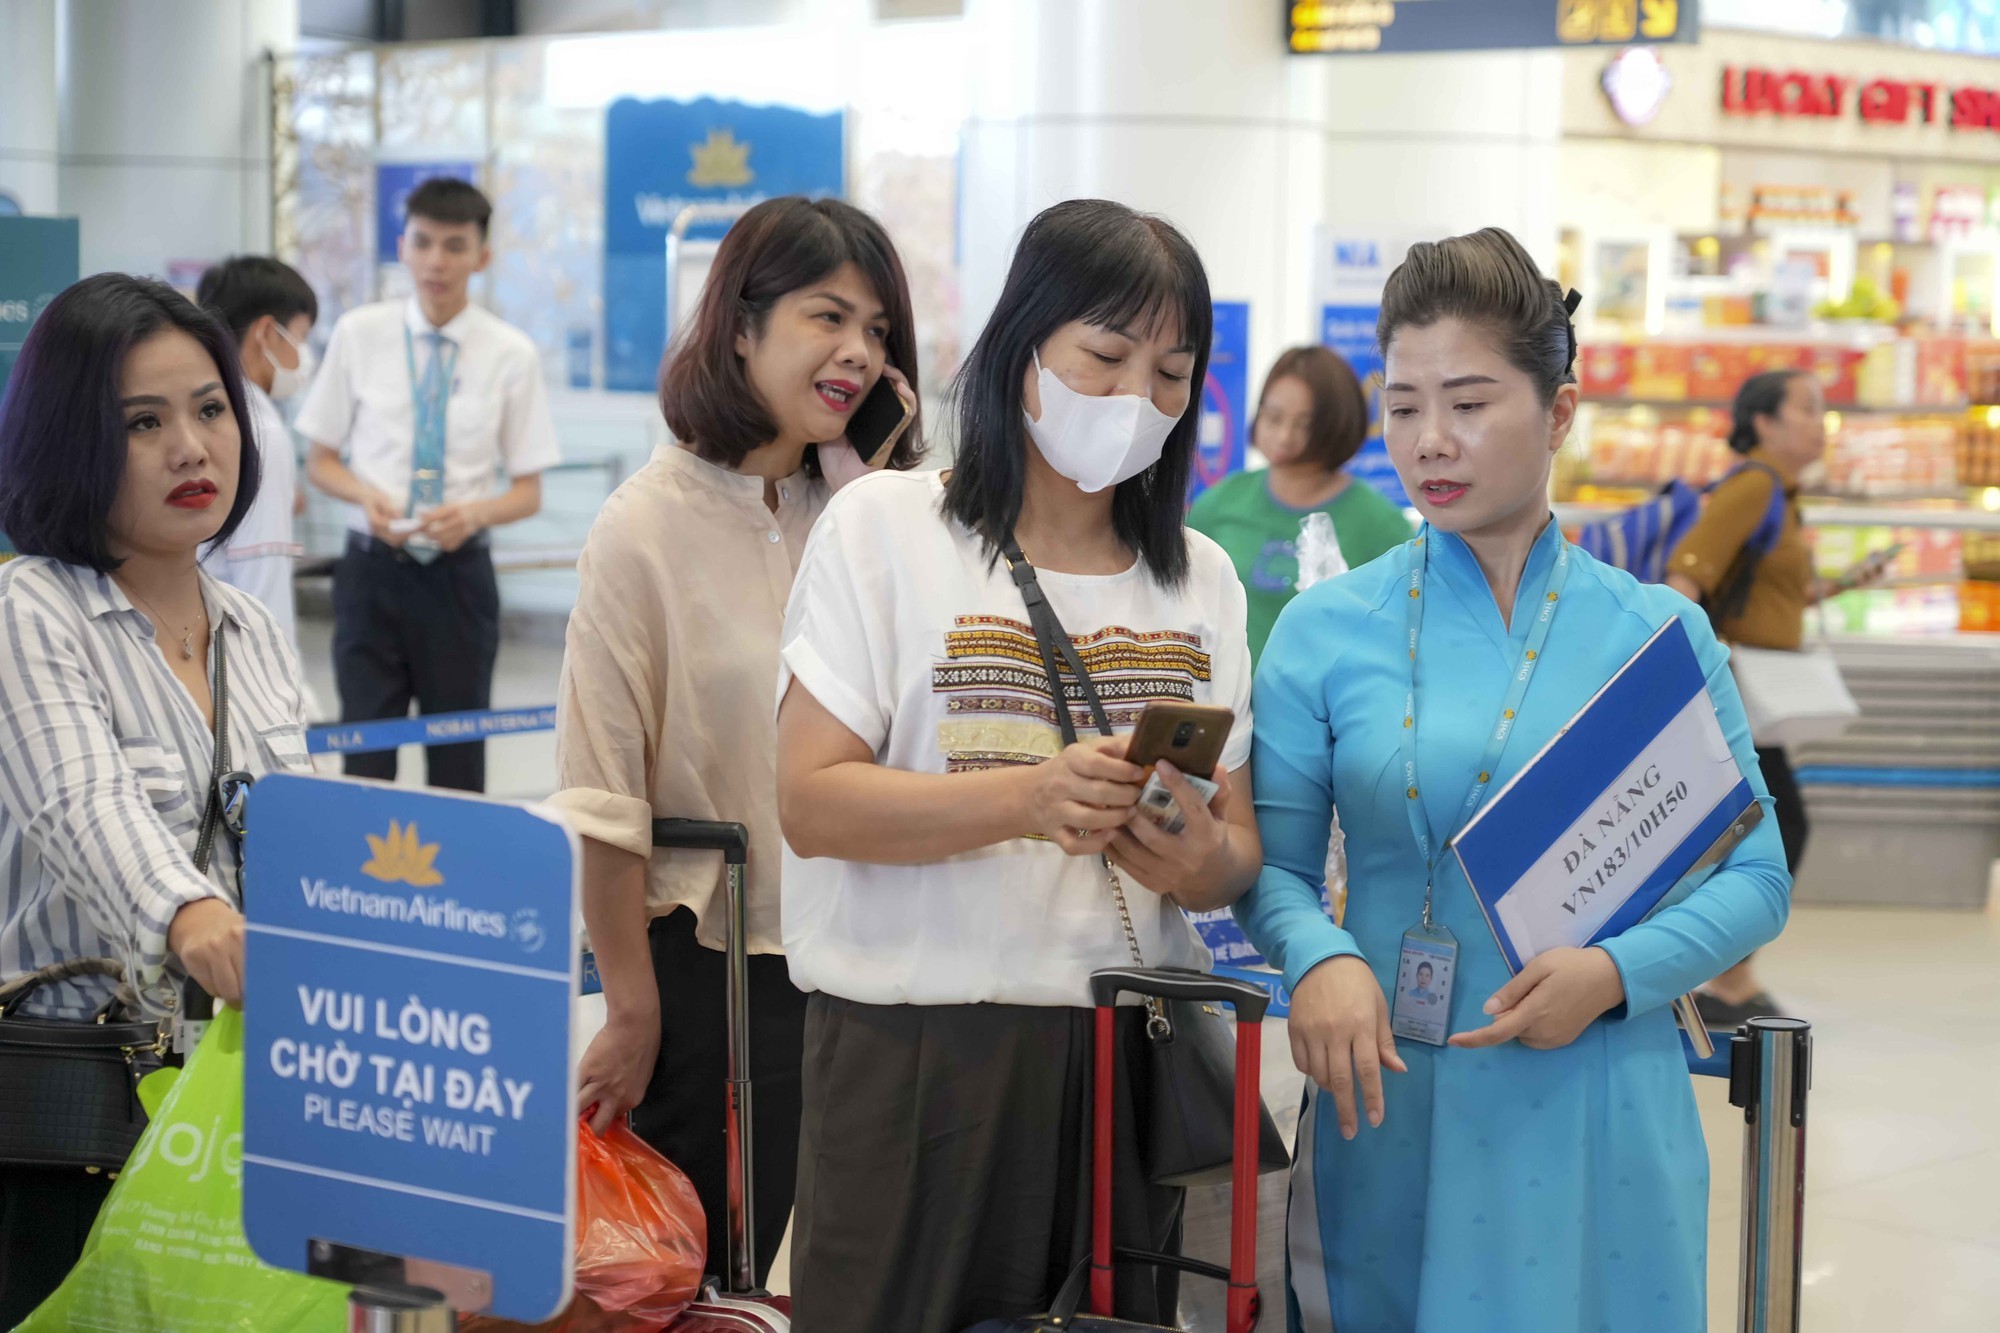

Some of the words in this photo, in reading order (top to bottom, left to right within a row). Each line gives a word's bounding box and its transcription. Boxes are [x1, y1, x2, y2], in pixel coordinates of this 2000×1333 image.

[1411, 568, 1419, 588] VIAGS
[1540, 602, 1553, 622] VIAGS
[1518, 661, 1532, 682] VIAGS
[1497, 719, 1510, 741] VIAGS
[1405, 761, 1414, 787] VIAGS
[1466, 784, 1483, 808] VIAGS
[1561, 780, 1688, 916] VN183/10H50
[1562, 832, 1598, 876] ĐÀ
[297, 983, 365, 1034] VUI
[375, 993, 491, 1055] LÒNG
[270, 1036, 362, 1089] CHỜ
[368, 1053, 435, 1110] TẠI
[443, 1064, 534, 1121] ĐÂY
[304, 1092, 415, 1143] PLEASE
[421, 1114, 497, 1156] WAIT
